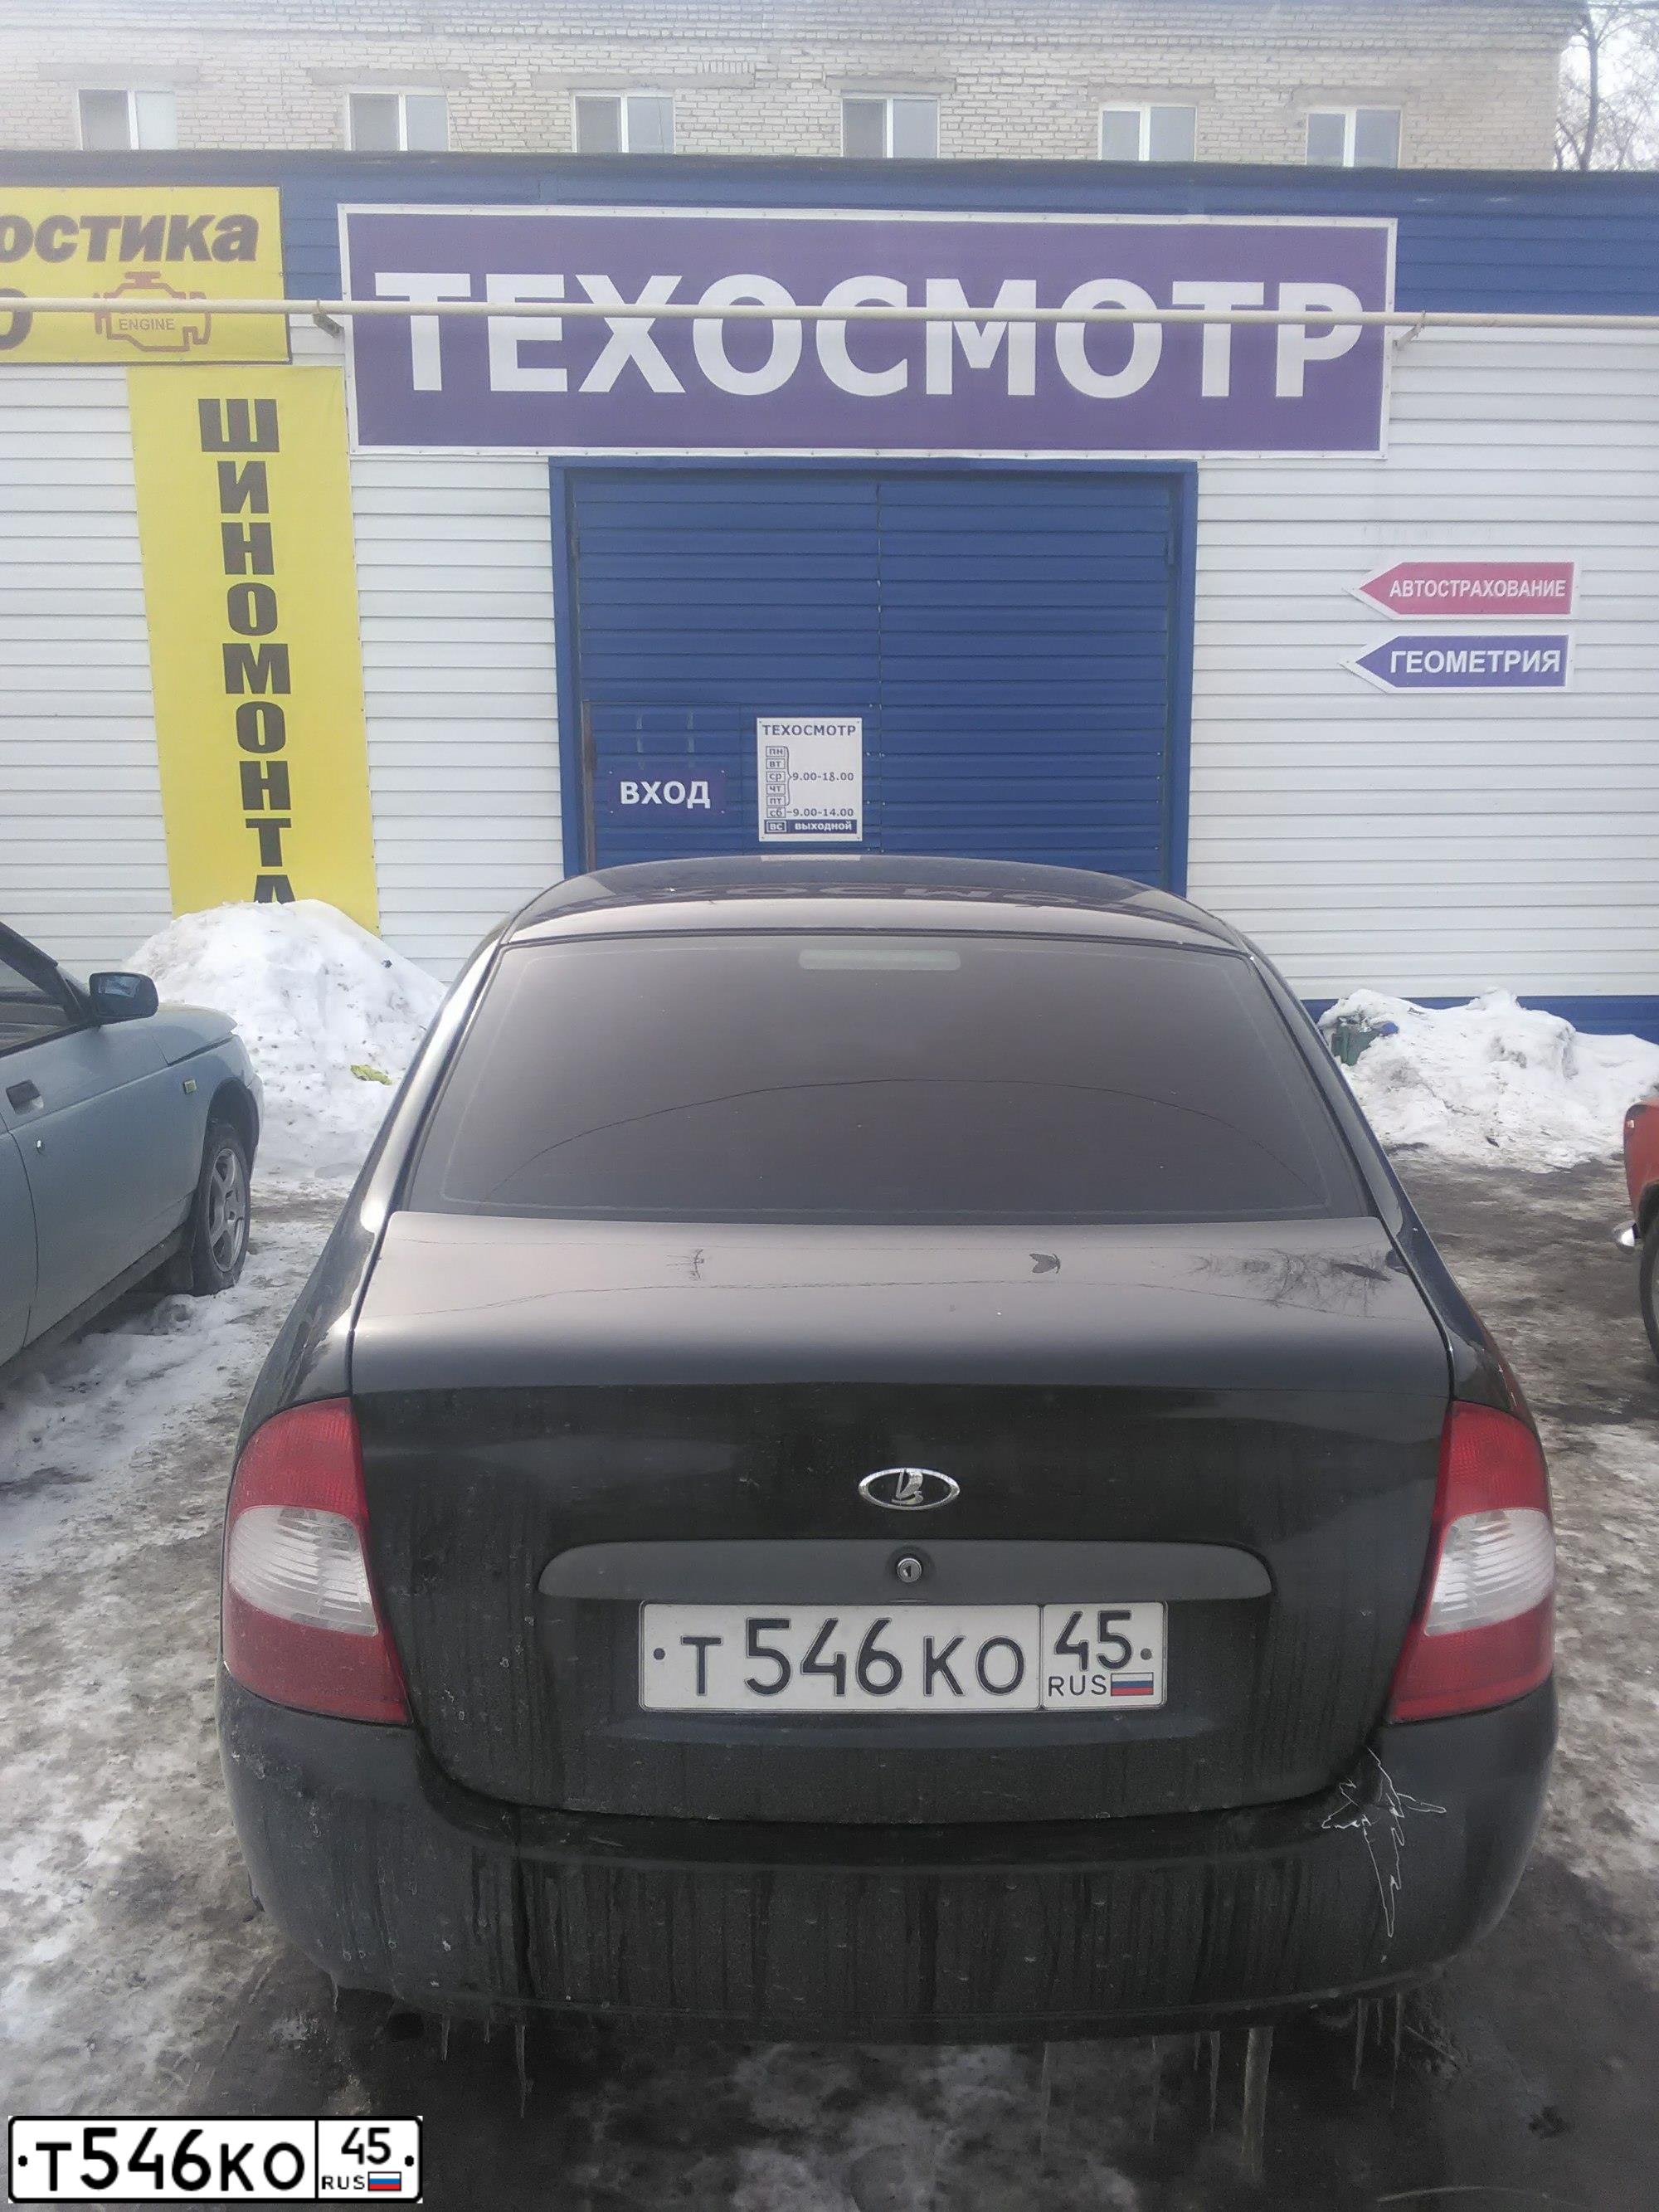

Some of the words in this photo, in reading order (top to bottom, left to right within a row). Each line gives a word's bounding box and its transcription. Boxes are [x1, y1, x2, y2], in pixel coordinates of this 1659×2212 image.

[119, 318, 175, 331] ENGINE
[375, 272, 1363, 400] ТЕХОСМОТР
[1389, 579, 1567, 598] АВТОСТРАХОВАНИЕ
[1389, 650, 1561, 674] ГЕОМЕТРИЯ
[762, 724, 856, 736] ТЕХОСМОТР
[620, 781, 711, 809] ВХОД
[1053, 1610, 1133, 1671] 45
[1048, 1674, 1107, 1697] RUS
